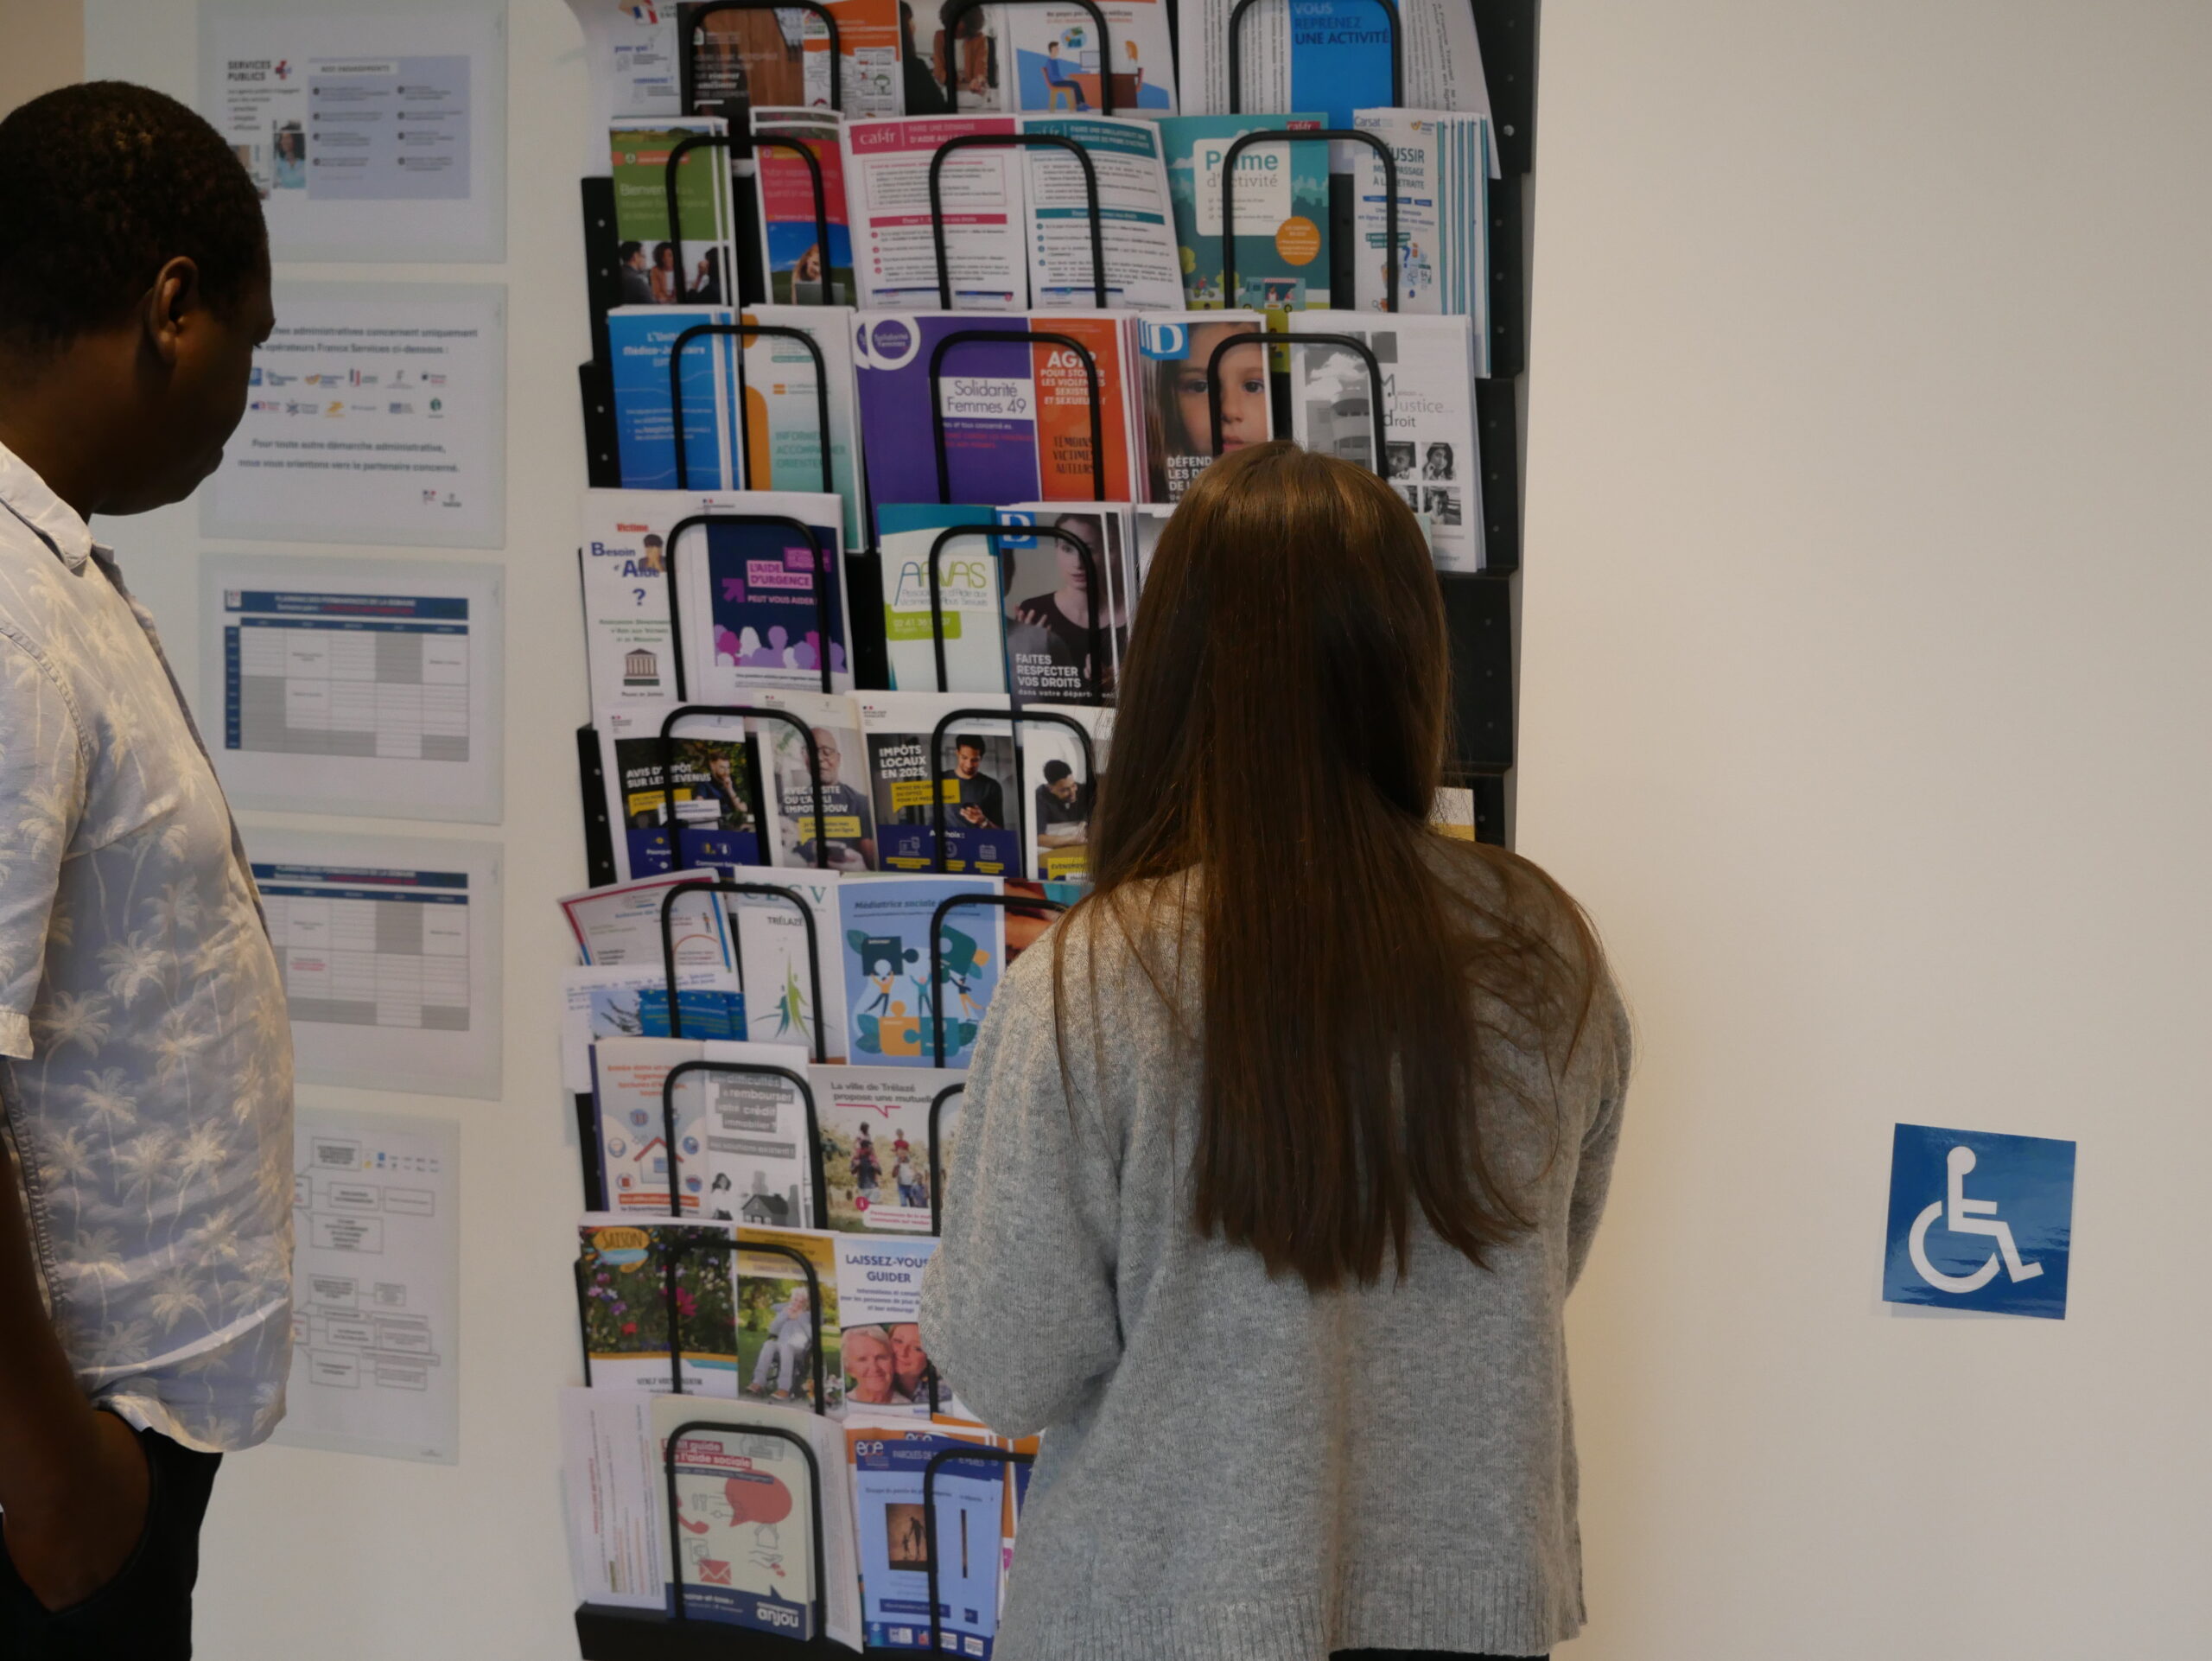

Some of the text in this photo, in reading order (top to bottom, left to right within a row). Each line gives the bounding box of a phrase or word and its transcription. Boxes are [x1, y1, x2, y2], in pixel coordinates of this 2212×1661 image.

[1295, 3, 1332, 14] VOUS
[1295, 17, 1362, 29] REPRENEZ
[1295, 29, 1389, 44] UNE ACTIVITÉ
[1205, 150, 1279, 172] Pime
[1206, 173, 1279, 188] d'ctivité
[1150, 324, 1184, 353] D
[954, 379, 1018, 398] Solidarité
[947, 397, 1027, 414] Femmes 49
[1167, 455, 1213, 468] DÉFEND
[1168, 469, 1189, 480] LES
[591, 542, 636, 557] Besoin
[750, 563, 782, 573] L'AIDE
[751, 576, 810, 586] D'URGENCE
[1015, 653, 1052, 665] FAITES
[1017, 665, 1078, 677] RESPECTER
[1018, 676, 1081, 688] VOS DROITS
[879, 744, 922, 758] IMPÔTS
[880, 756, 927, 768] LOCAUX
[626, 767, 651, 779] AVIS
[881, 768, 899, 779] EN
[626, 779, 647, 789] SUR
[831, 1082, 843, 1091] La
[846, 1082, 864, 1091] ville
[833, 1093, 873, 1103] propose
[867, 1271, 912, 1282] GUIDER
[690, 1441, 721, 1453] guide
[756, 1608, 799, 1628] anjou
